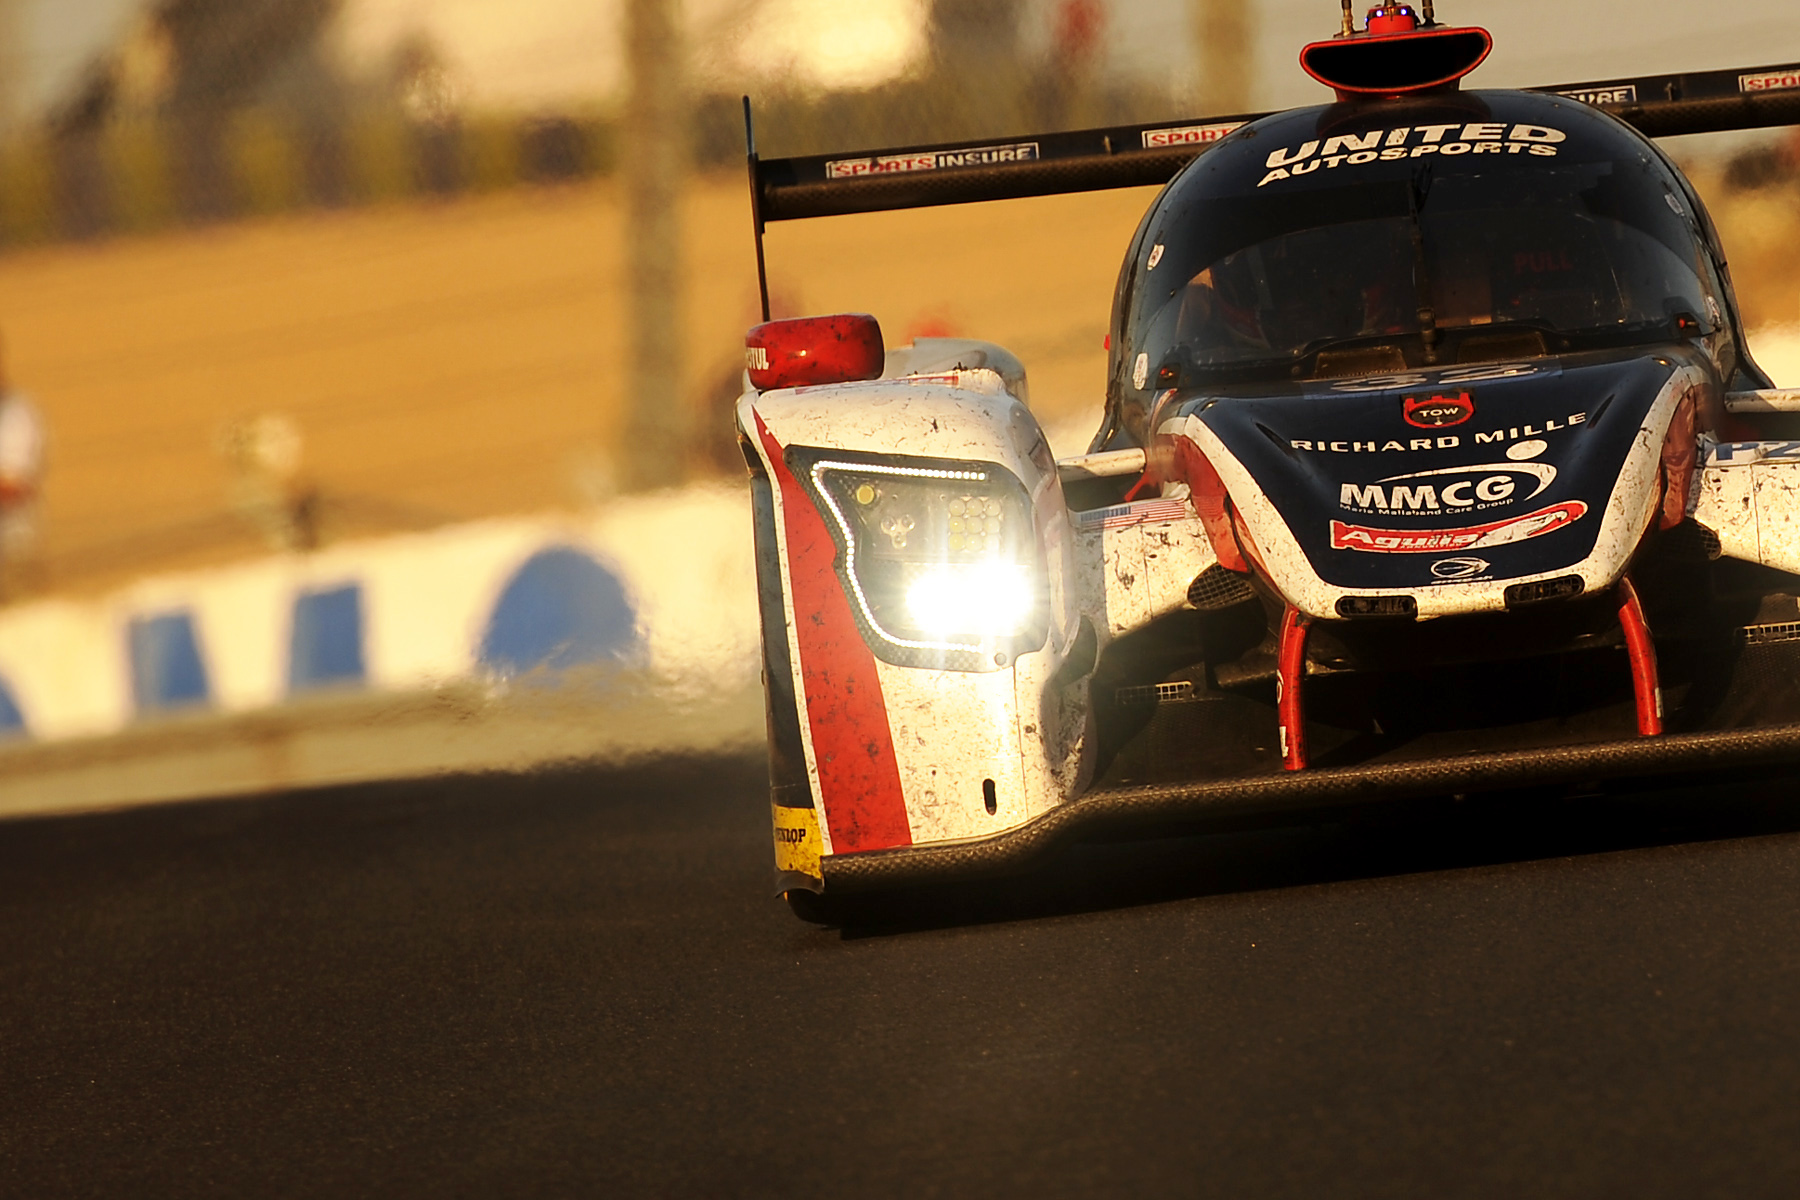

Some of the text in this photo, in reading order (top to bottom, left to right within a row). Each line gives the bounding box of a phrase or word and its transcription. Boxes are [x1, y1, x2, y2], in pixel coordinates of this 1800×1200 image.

[1151, 127, 1232, 145] SPORT
[1265, 123, 1567, 168] UNITED
[1257, 142, 1558, 187] AUTOSPORTS
[1513, 250, 1574, 274] PULL
[1419, 407, 1459, 418] TOW
[1290, 412, 1587, 453] RICHARD MILLE
[1340, 475, 1515, 509] MMCG
[1378, 508, 1442, 516] Mallaband
[1445, 505, 1473, 514] Care
[1477, 498, 1515, 510] Group
